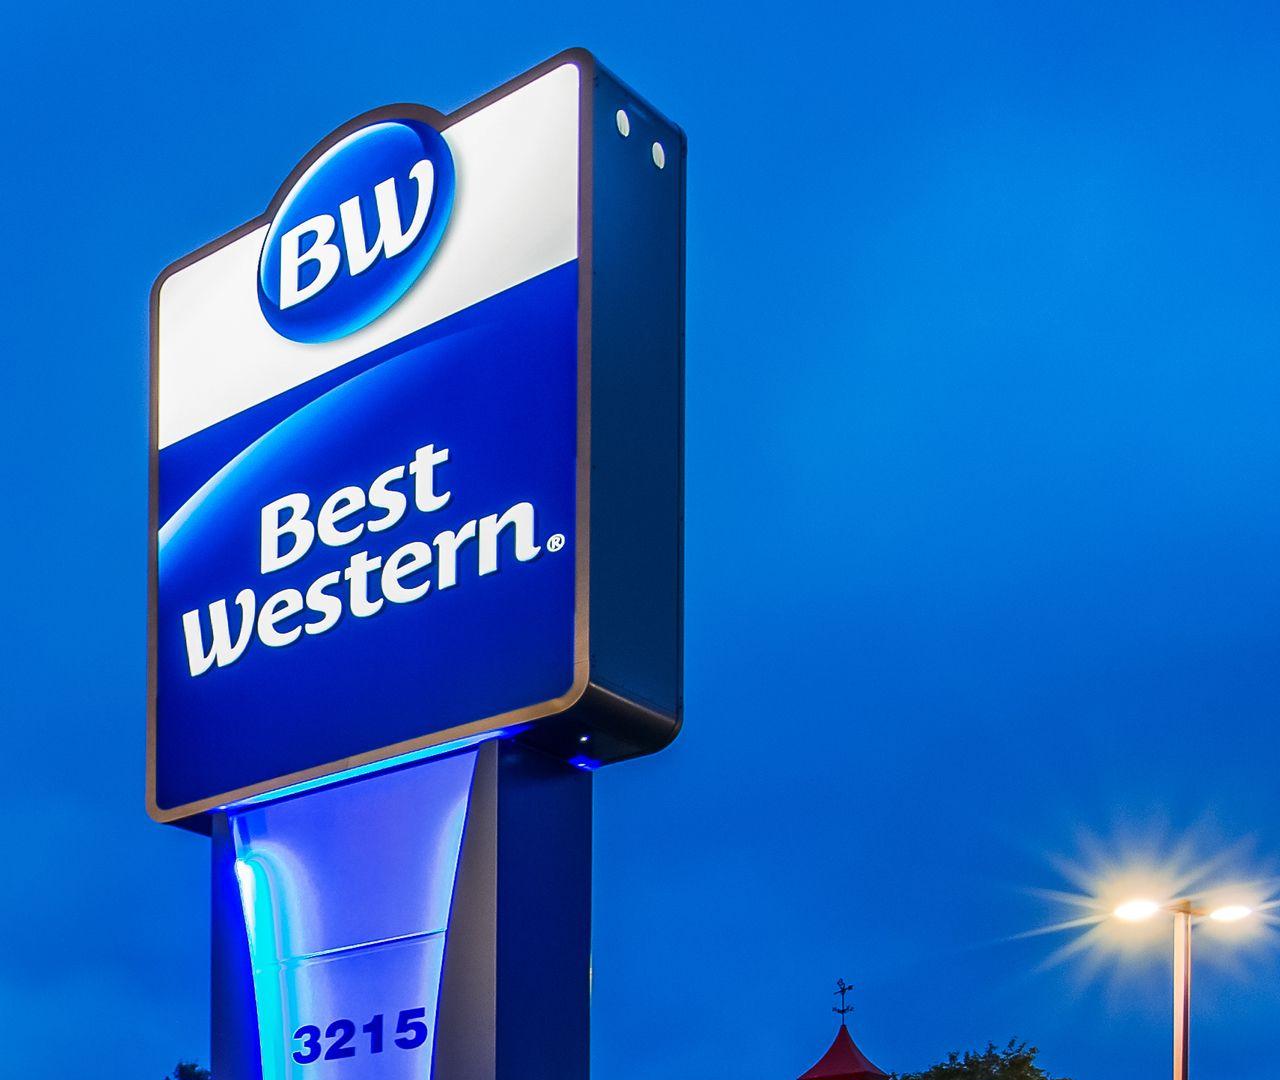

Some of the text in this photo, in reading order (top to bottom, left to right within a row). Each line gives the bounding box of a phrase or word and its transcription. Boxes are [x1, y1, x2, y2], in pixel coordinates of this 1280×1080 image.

[279, 159, 434, 310] BW
[260, 443, 450, 574] Best
[292, 1007, 428, 1064] 3215
